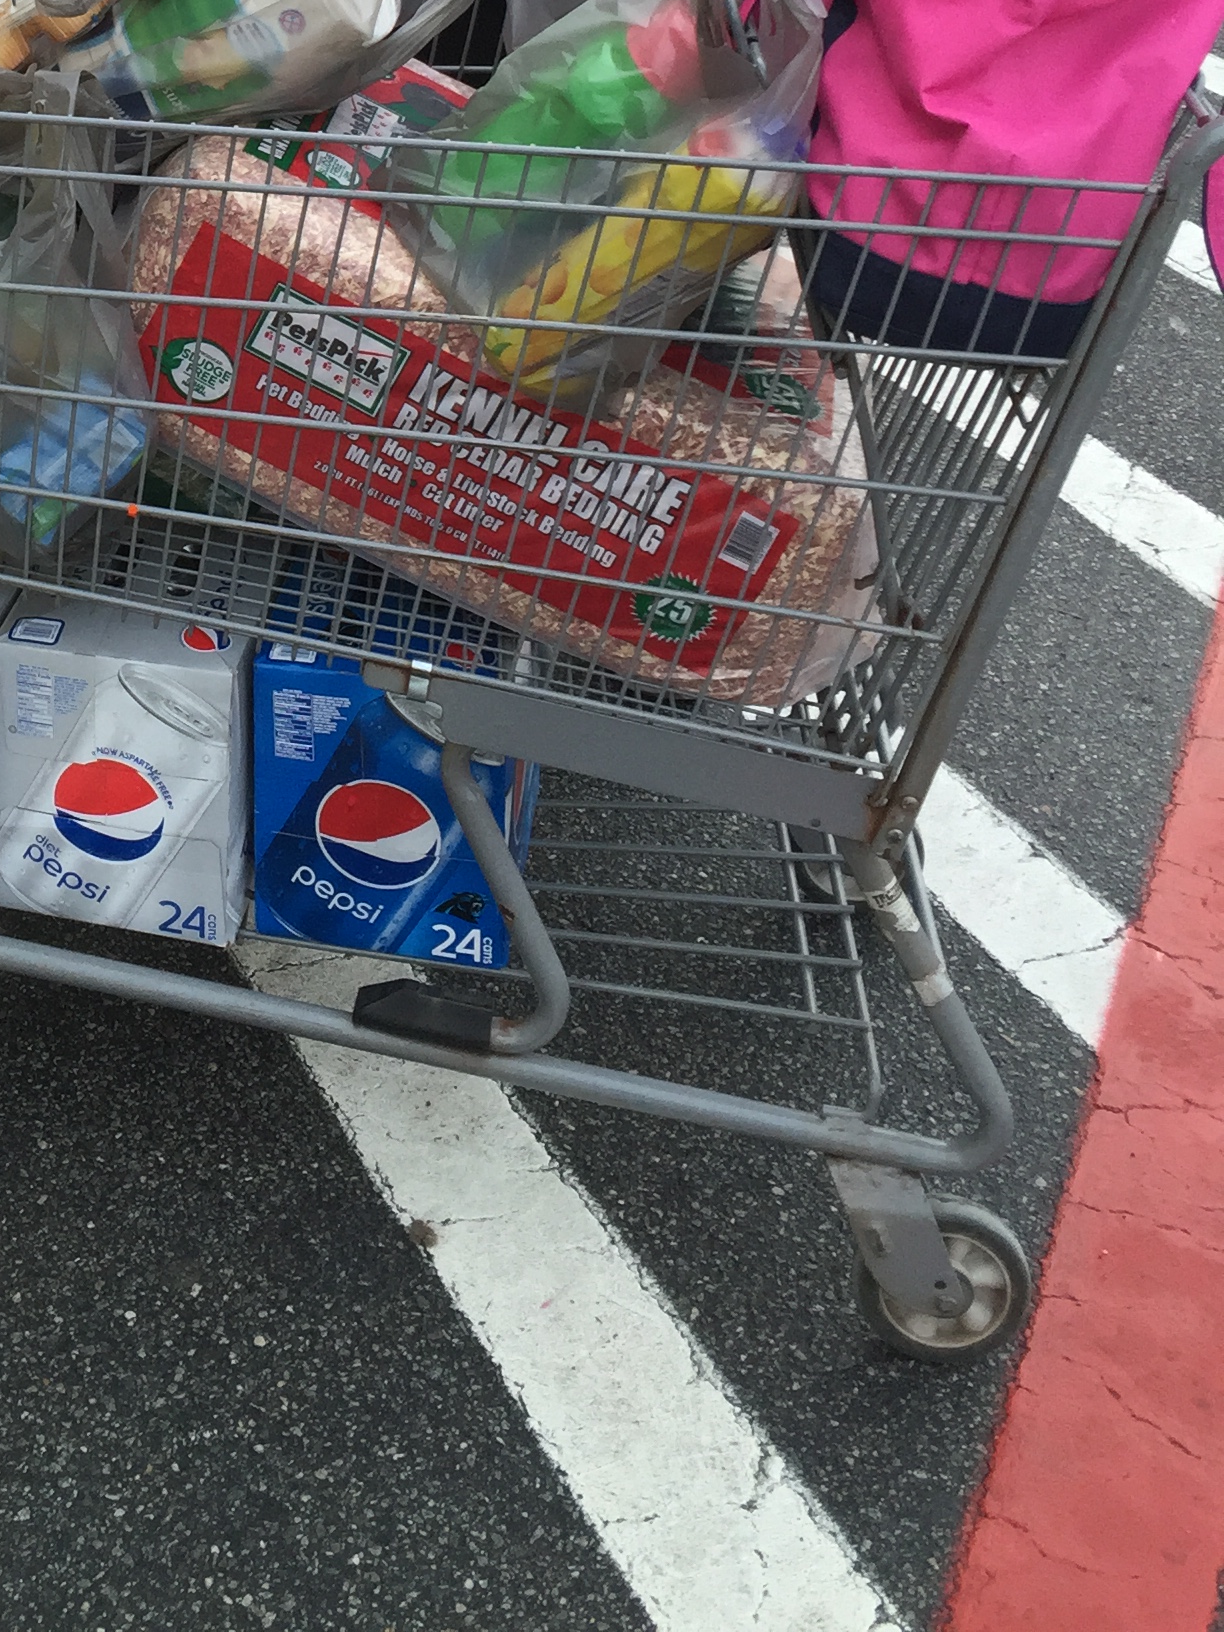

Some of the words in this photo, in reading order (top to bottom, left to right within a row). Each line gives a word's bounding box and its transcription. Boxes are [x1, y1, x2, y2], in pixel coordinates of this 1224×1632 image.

[181, 348, 233, 383] SLUDGE
[270, 310, 387, 384] PetsPick
[255, 374, 286, 402] Pet
[287, 390, 360, 441] Beddg
[382, 494, 423, 521] EXPNDS
[573, 439, 692, 525] CARE
[453, 496, 505, 532] Liter
[538, 472, 666, 556] BEDDING
[96, 746, 119, 756] NOW
[155, 780, 172, 801] FREE
[22, 842, 111, 904] pepsi
[34, 834, 63, 859] diet
[158, 899, 206, 939] 24
[207, 914, 217, 941] cans
[290, 865, 385, 924] pepsi
[431, 923, 482, 963] 24
[482, 936, 493, 965] cans
